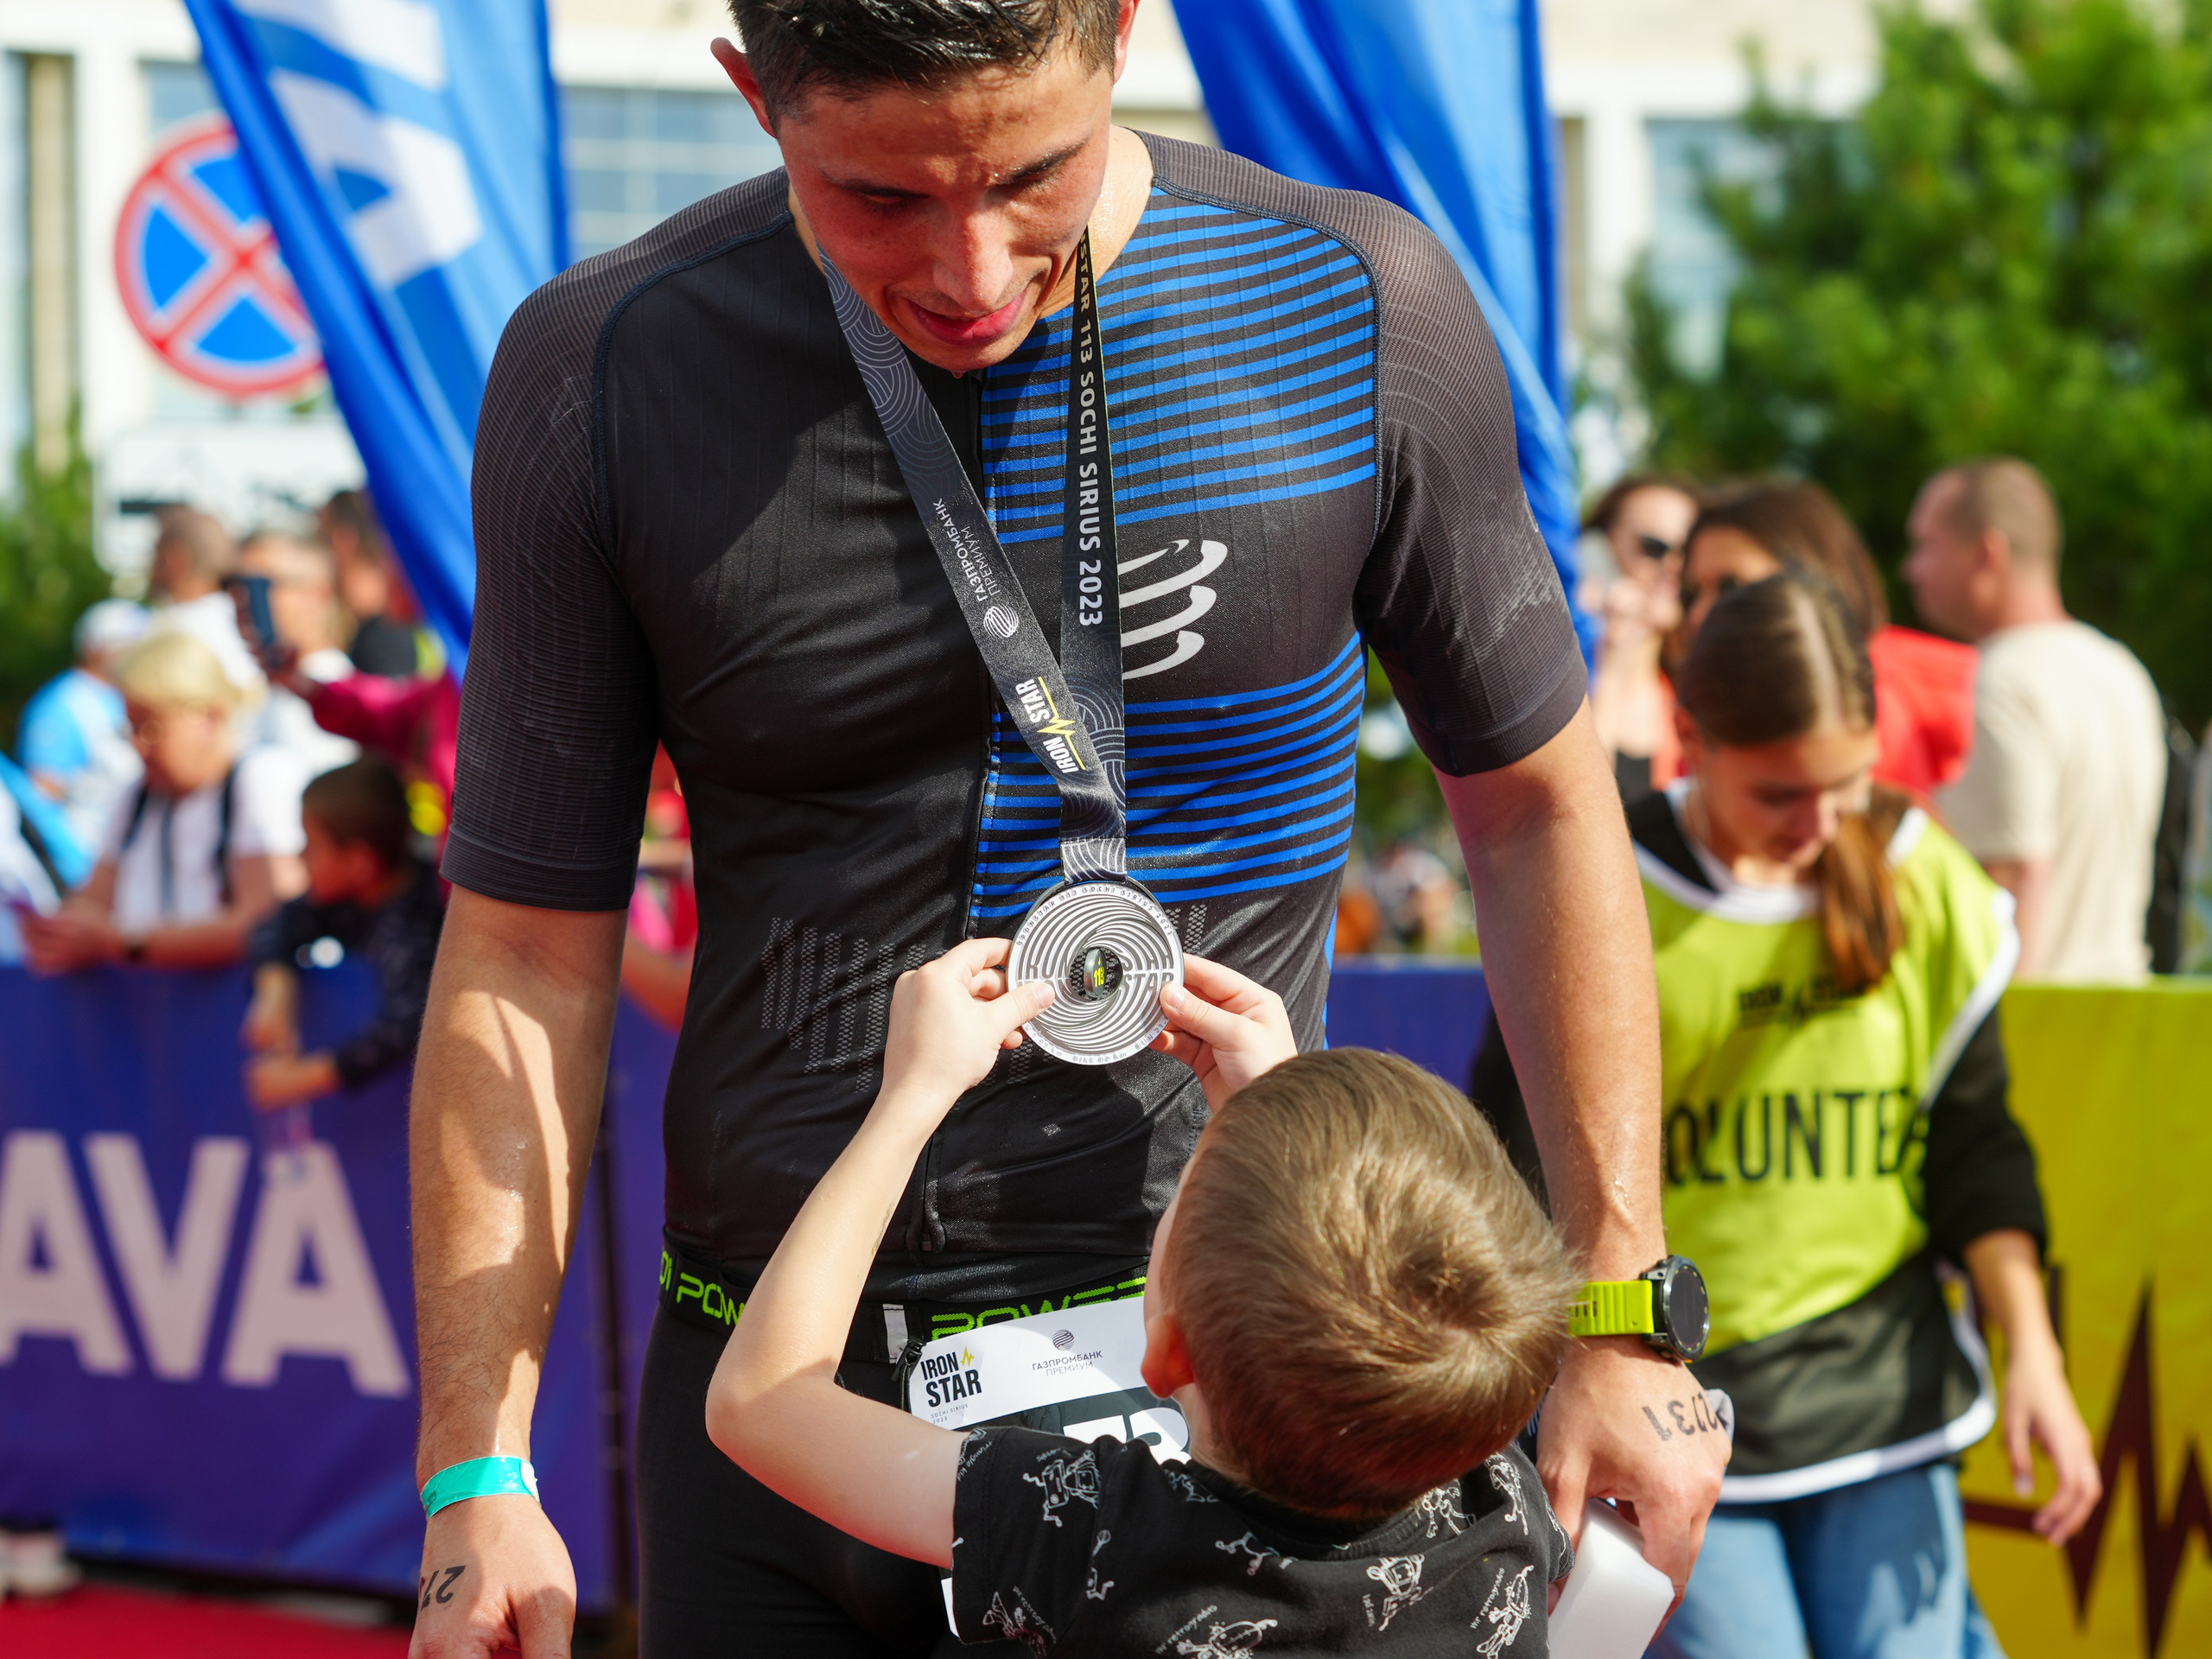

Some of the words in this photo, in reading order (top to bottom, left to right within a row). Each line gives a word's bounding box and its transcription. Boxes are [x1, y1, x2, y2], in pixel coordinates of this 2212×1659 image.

[1080, 321, 1093, 364] 113
[1080, 372, 1097, 453] SOCHI
[1079, 462, 1101, 551] SIRIUS
[934, 498, 988, 602] ГАЗПРОМБАНК
[962, 526, 1001, 596] ПРЕМИУМ
[1079, 561, 1103, 626] 2023
[1015, 679, 1050, 723] STAR
[1043, 736, 1079, 774] IRON
[1121, 890, 1154, 910] SIRIUS
[1156, 913, 1173, 935] 2023
[676, 1272, 745, 1325] POW
[920, 1351, 959, 1380] IRON
[1032, 1351, 1103, 1371] ГАЗПРОМБАНК
[1046, 1361, 1094, 1376] ПРЕМИУМ
[926, 1370, 982, 1408] STAR
[931, 1409, 949, 1419] SOCHI
[950, 1403, 969, 1413] SIRIUS
